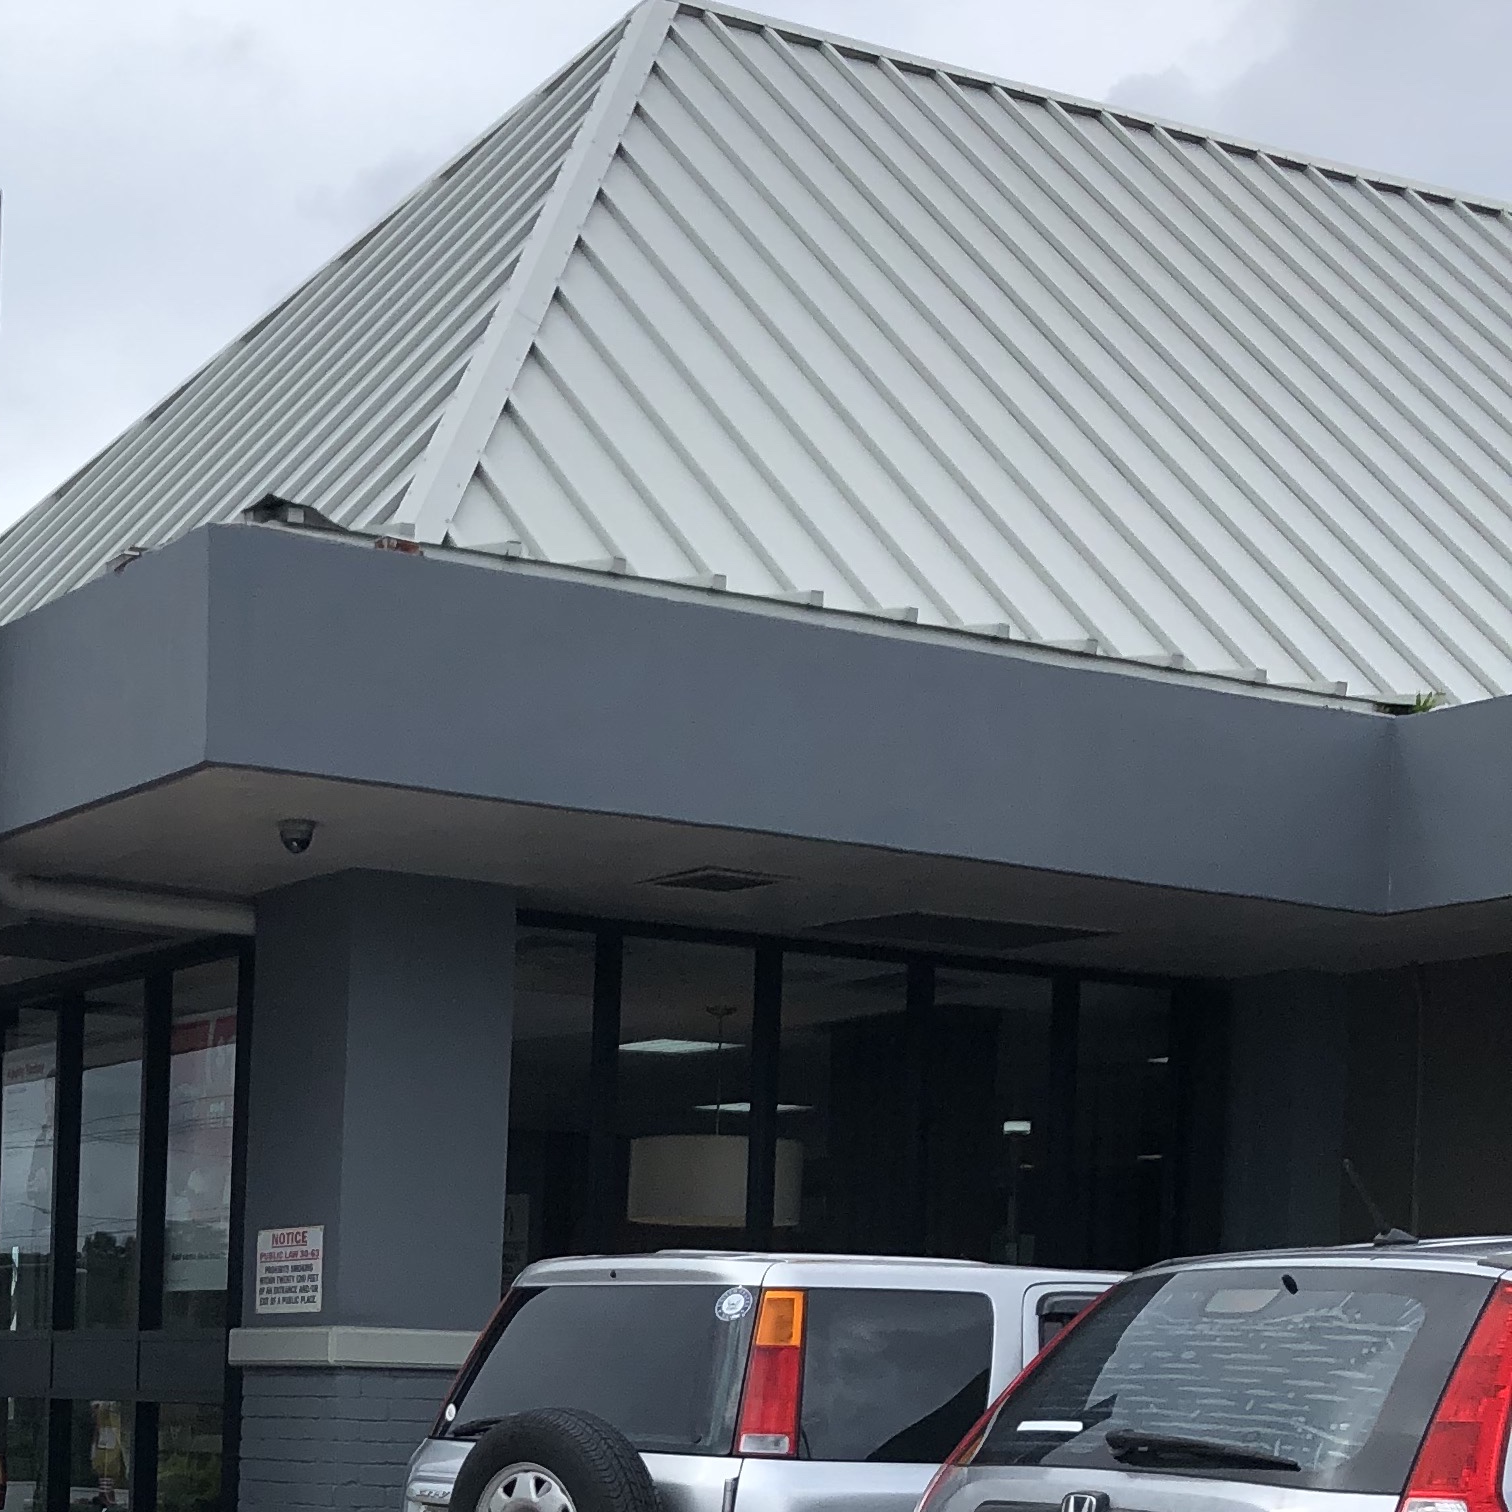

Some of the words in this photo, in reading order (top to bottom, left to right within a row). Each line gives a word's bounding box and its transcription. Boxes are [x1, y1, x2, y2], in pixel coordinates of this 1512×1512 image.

[272, 1231, 308, 1246] NOTICE
[260, 1251, 284, 1260] PUBLIC
[285, 1250, 299, 1259] LAW
